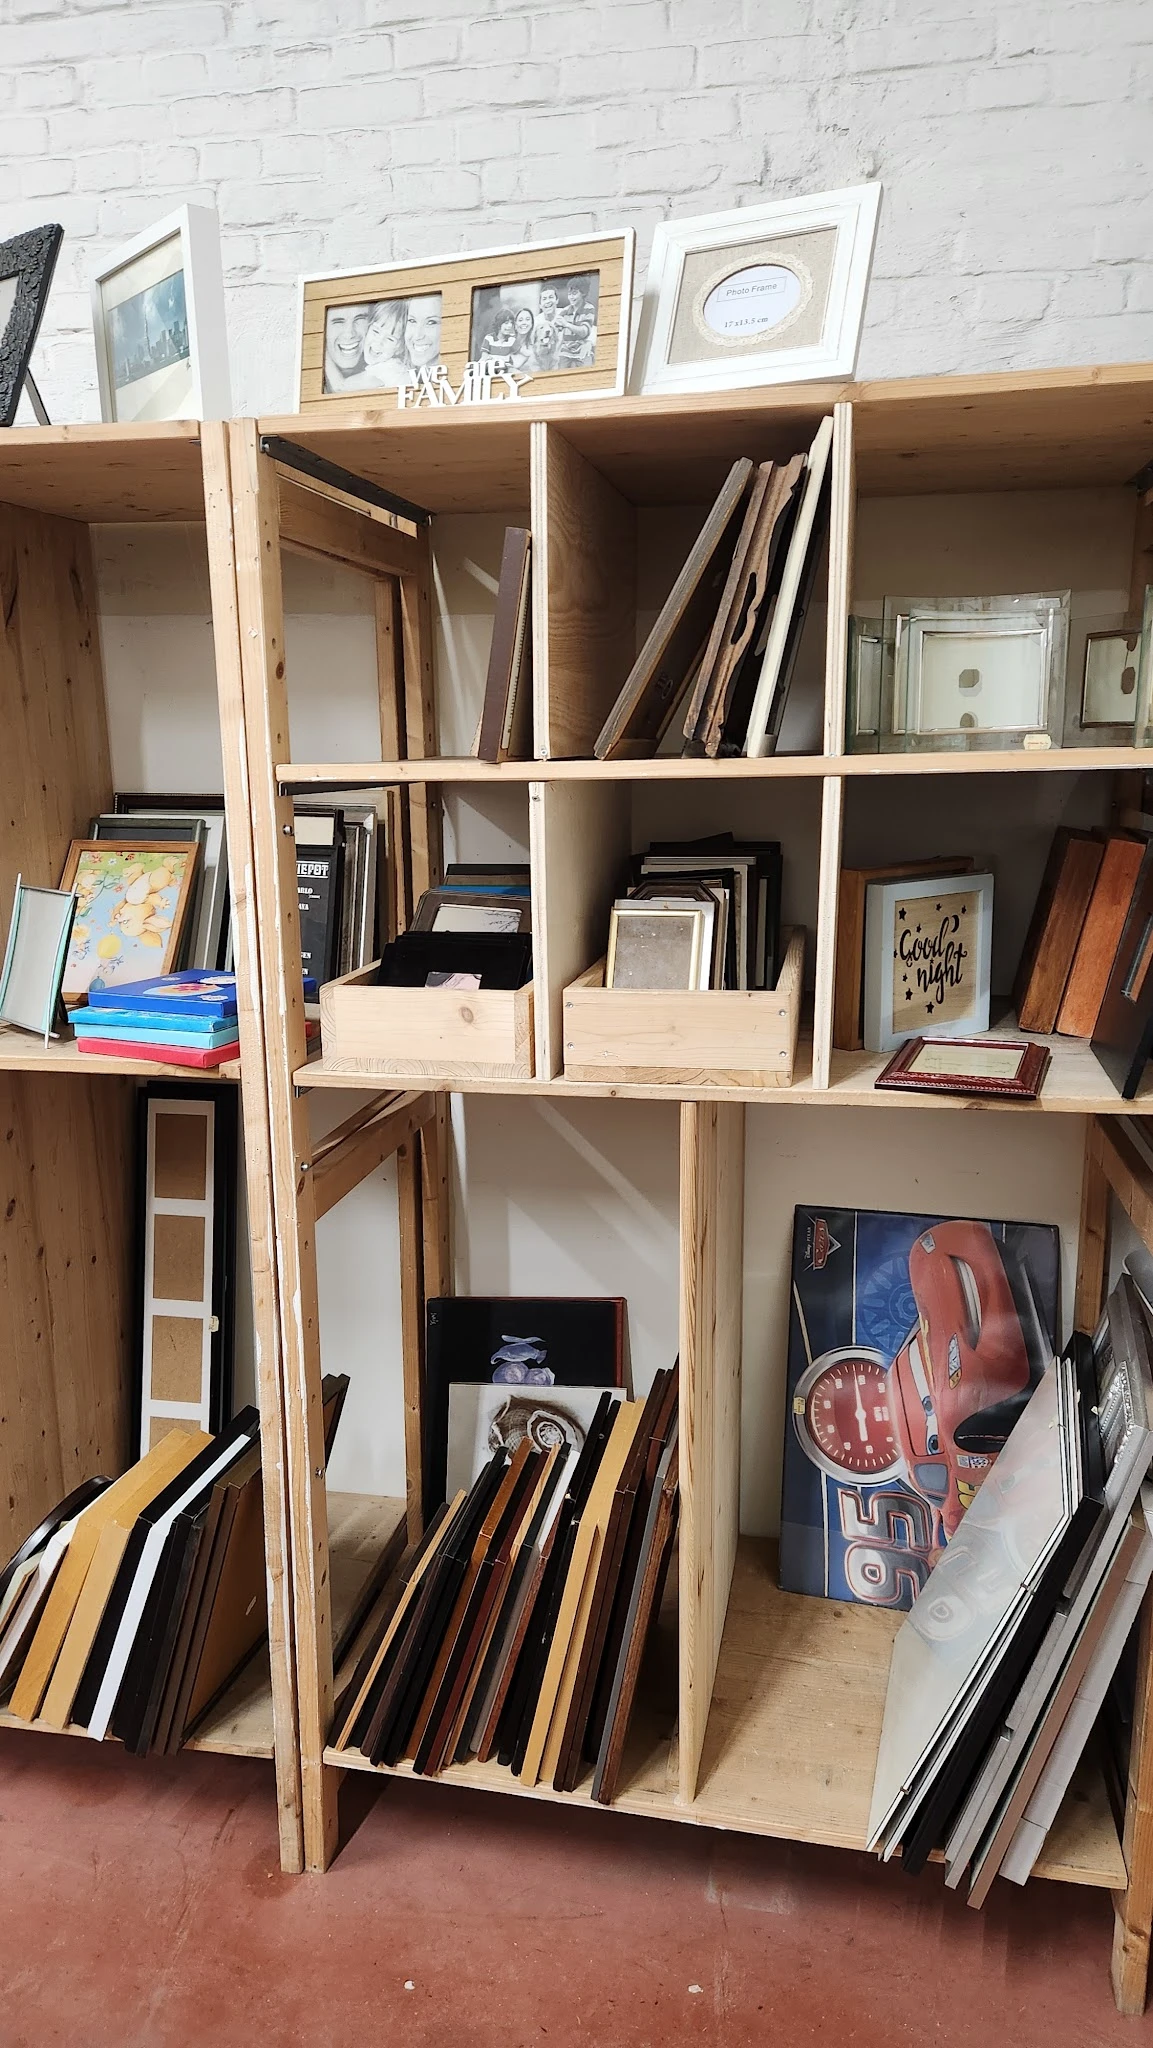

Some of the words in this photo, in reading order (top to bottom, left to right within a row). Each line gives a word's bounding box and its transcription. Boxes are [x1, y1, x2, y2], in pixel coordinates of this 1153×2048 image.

[726, 288, 750, 297] Photo
[751, 283, 778, 293] Frame
[396, 371, 534, 409] FAMILY
[409, 364, 449, 386] we
[463, 357, 508, 377] are
[900, 916, 950, 968] Good
[916, 940, 968, 1004] night
[838, 1488, 934, 1606] 95
